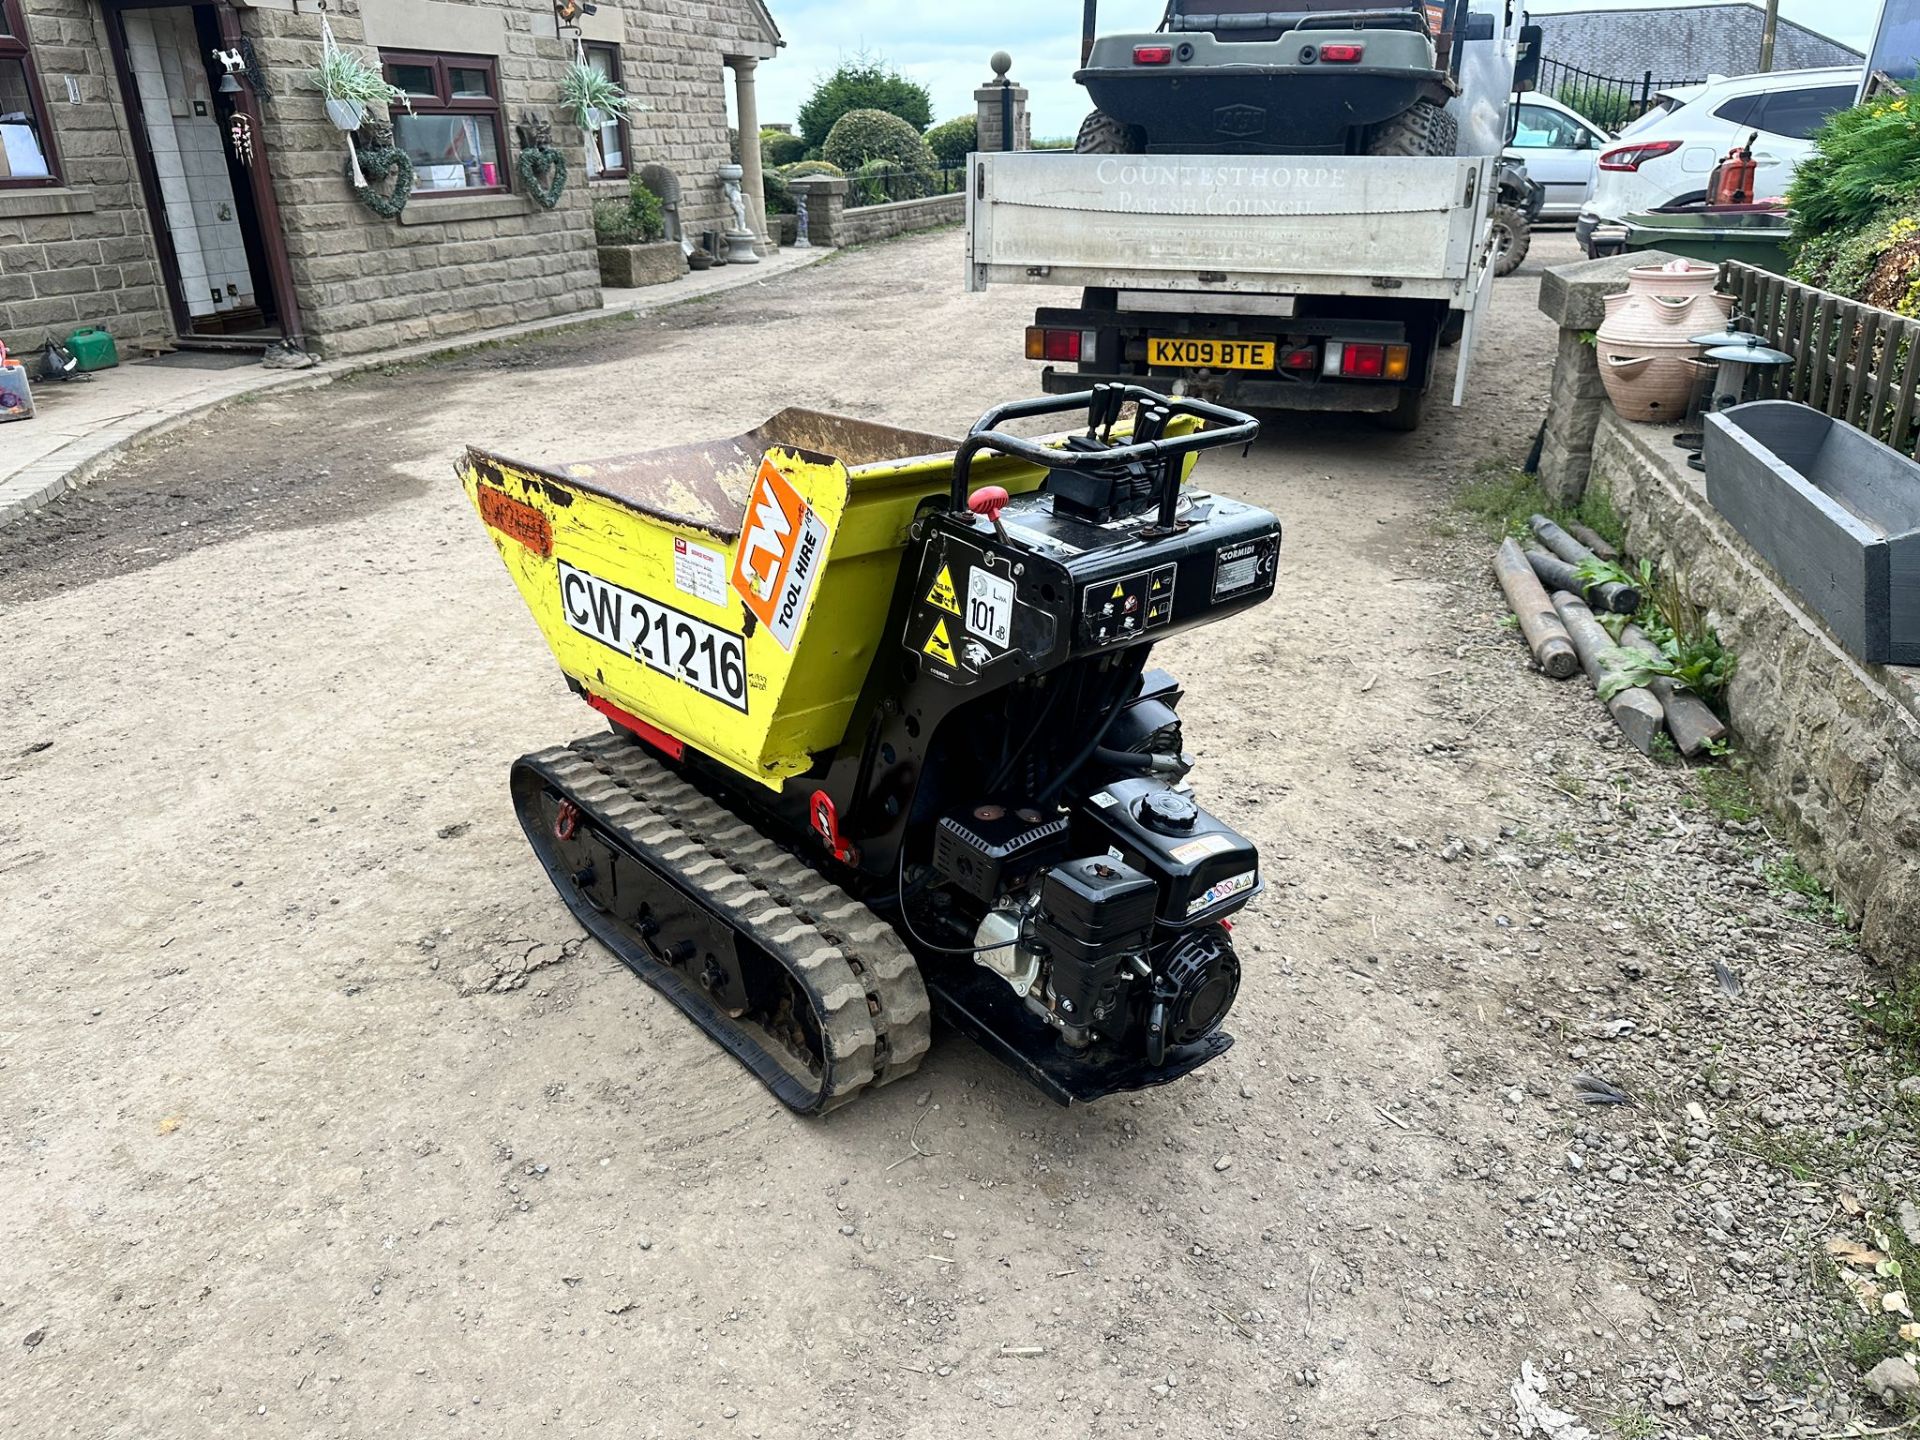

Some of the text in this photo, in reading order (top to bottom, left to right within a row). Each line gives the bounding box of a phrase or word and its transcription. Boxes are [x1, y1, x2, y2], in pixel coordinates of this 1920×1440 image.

[1096, 158, 1346, 189] COUNTESTHORPE
[1156, 341, 1265, 365] KX09 BTE
[740, 476, 793, 603] CW
[778, 530, 817, 631] TOOL HIRE
[564, 572, 622, 643] CW
[630, 603, 745, 700] 21216
[971, 598, 995, 636] 101
